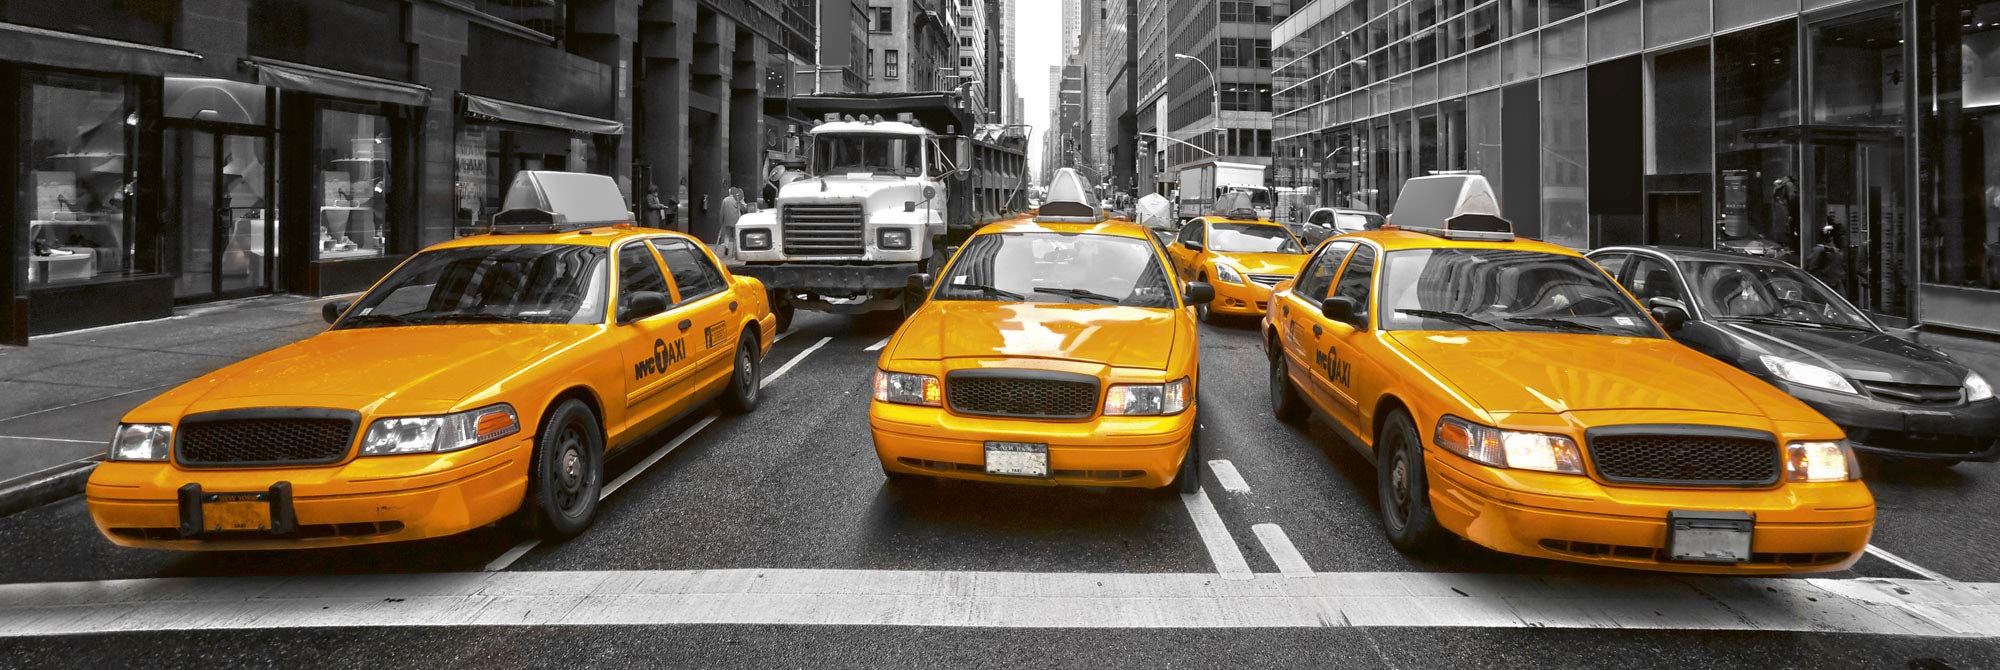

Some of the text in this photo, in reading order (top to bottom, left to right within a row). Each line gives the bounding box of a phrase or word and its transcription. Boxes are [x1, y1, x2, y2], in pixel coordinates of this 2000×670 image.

[634, 337, 686, 380] NYC TAXI
[1327, 345, 1351, 388] TAXI
